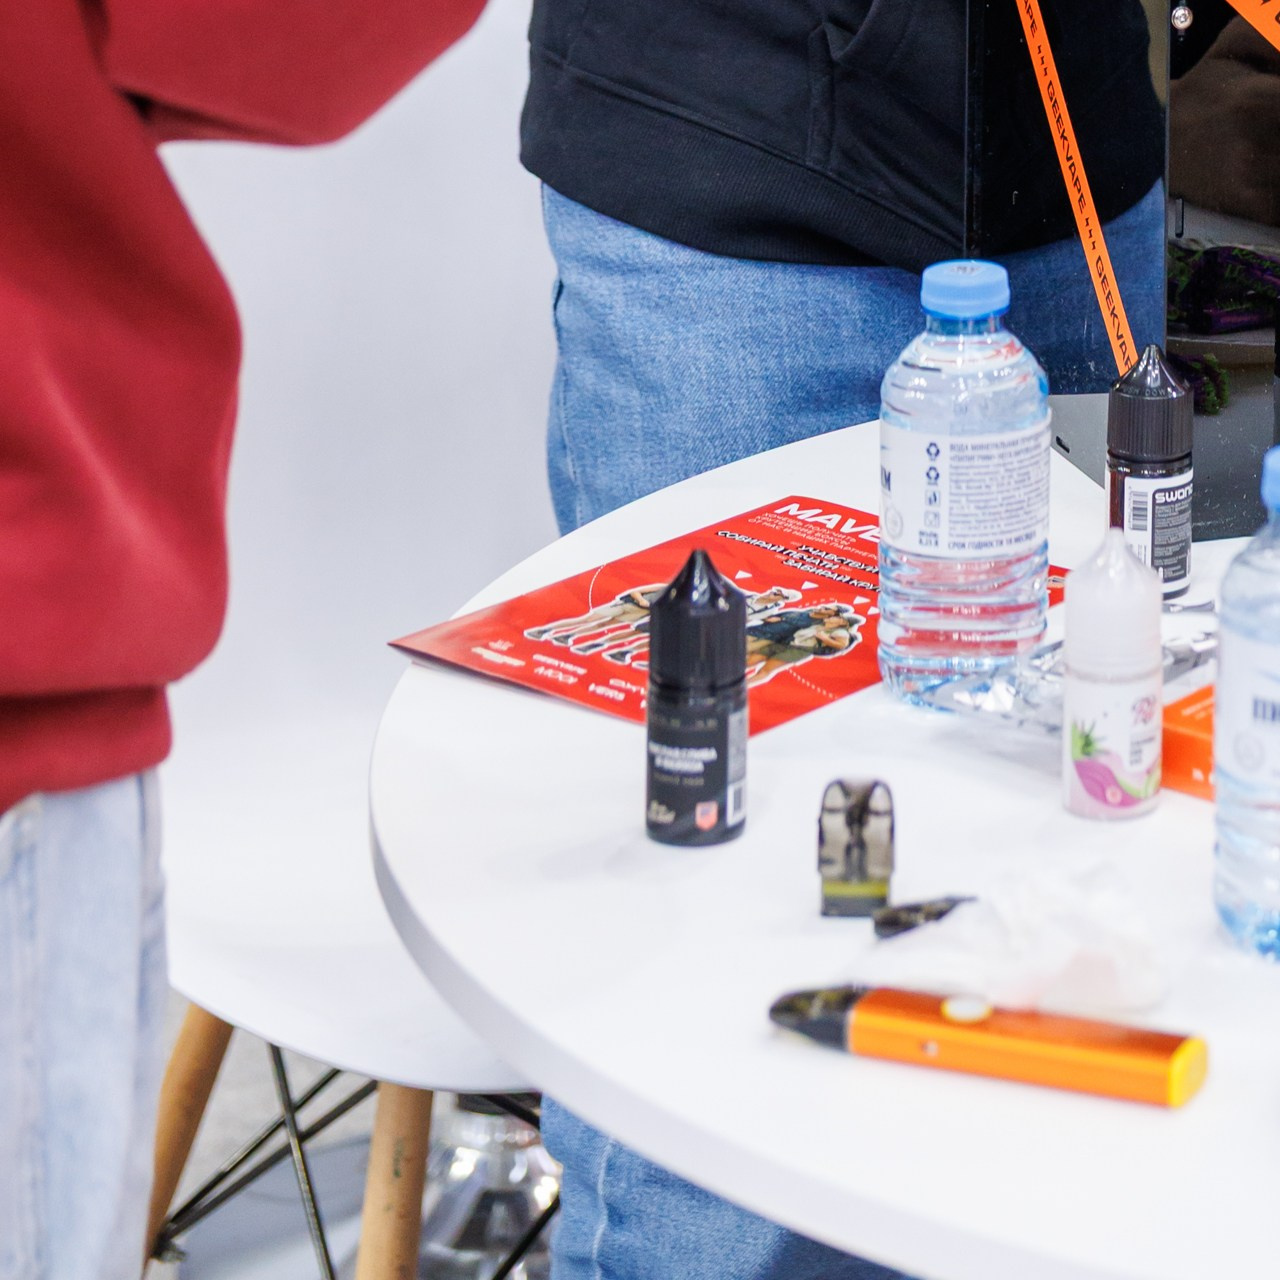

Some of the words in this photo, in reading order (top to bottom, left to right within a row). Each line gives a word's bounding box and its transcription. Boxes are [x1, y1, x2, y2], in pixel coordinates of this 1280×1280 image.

[1046, 79, 1087, 212] GEEKVAPE
[717, 530, 781, 553] СОБИРАЙ
[782, 548, 840, 570] ПЕЧАТИ
[782, 559, 851, 582] ЗАБИРАЙ
